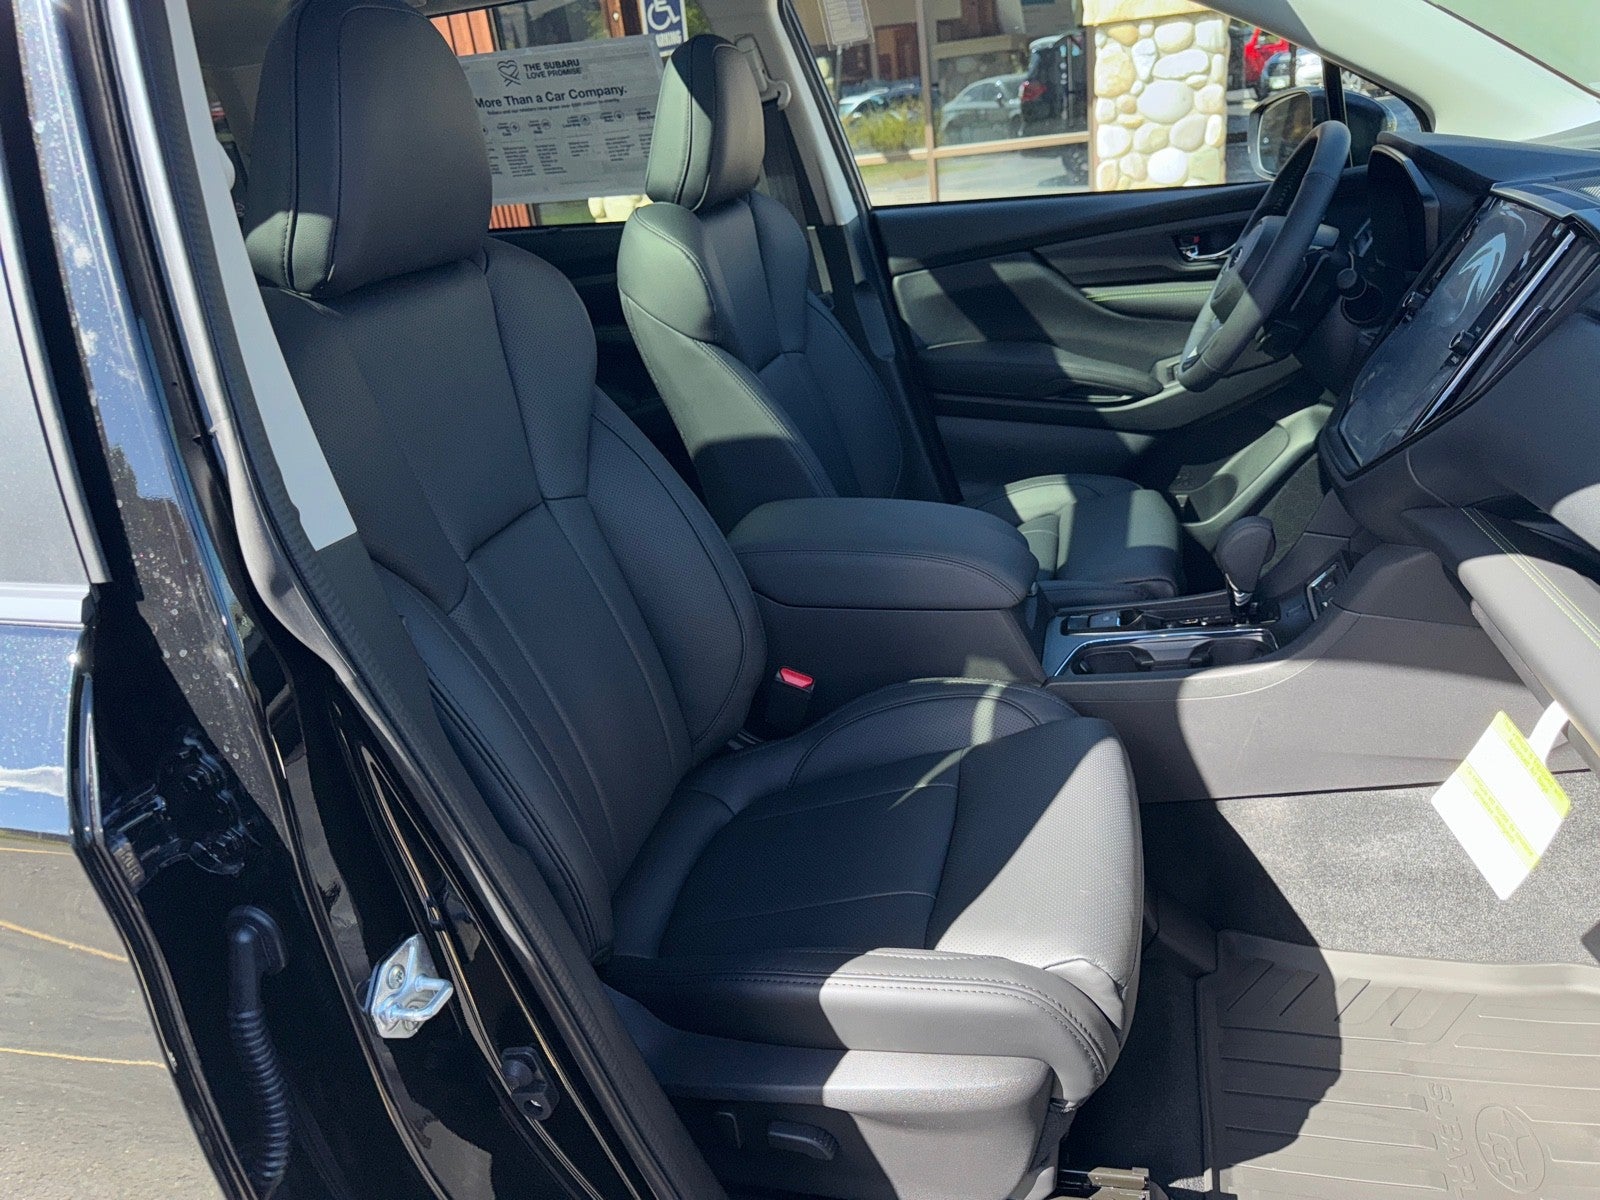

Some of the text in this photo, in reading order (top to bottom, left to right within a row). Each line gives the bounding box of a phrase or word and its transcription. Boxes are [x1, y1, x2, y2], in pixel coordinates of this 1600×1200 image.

[523, 59, 580, 72] THE SUBARU
[526, 67, 582, 79] LOVE PROMISE
[475, 97, 502, 108] More
[503, 96, 533, 106] Than
[535, 95, 543, 103] a
[545, 91, 566, 102] Car
[568, 85, 628, 99] Company.
